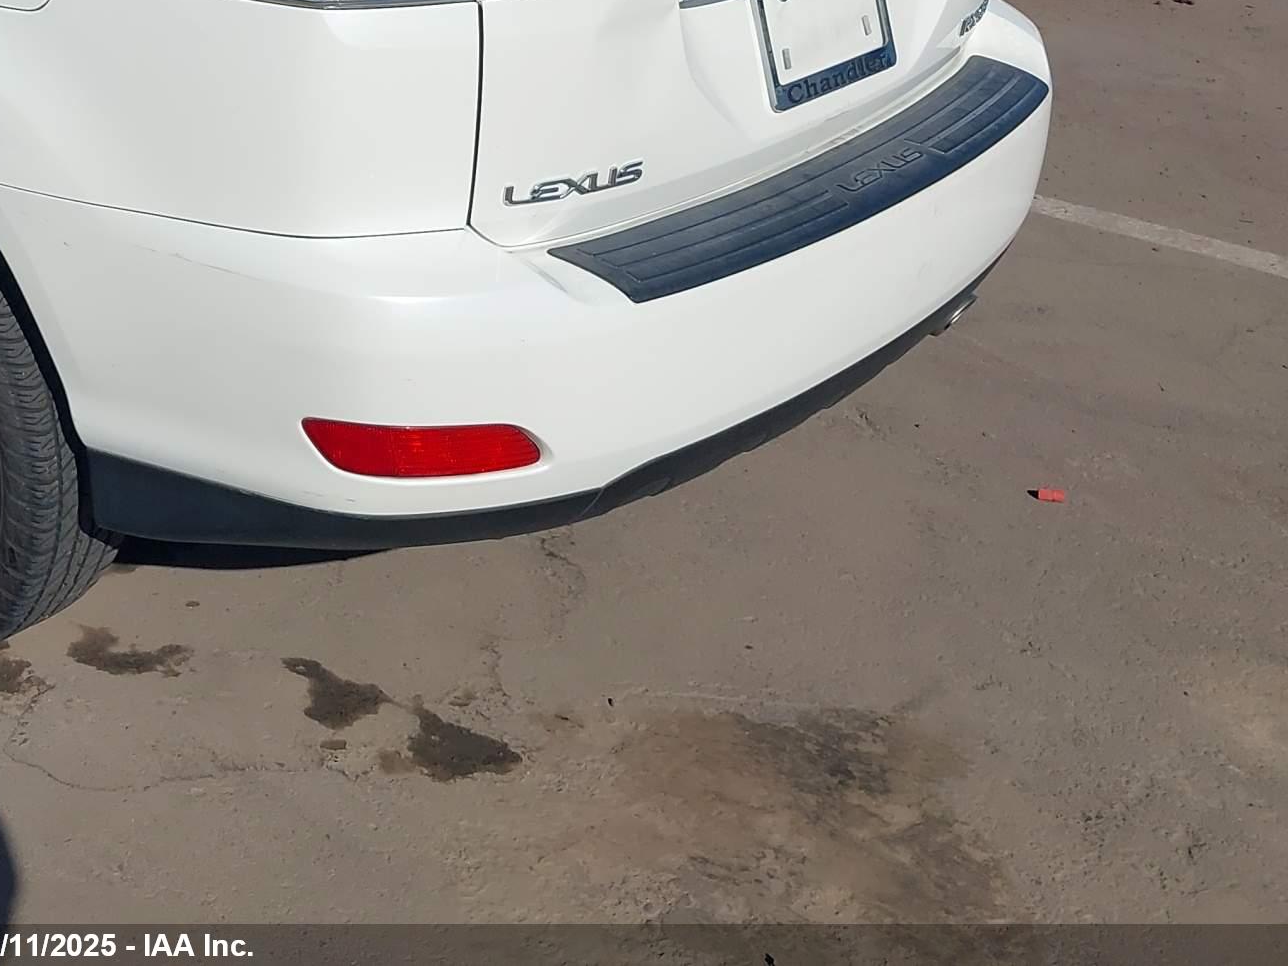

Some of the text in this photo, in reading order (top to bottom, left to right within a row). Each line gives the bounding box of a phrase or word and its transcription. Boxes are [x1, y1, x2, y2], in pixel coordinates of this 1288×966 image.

[787, 52, 892, 104] Chandler
[503, 159, 644, 207] LEXUS
[835, 147, 924, 192] LEXUS
